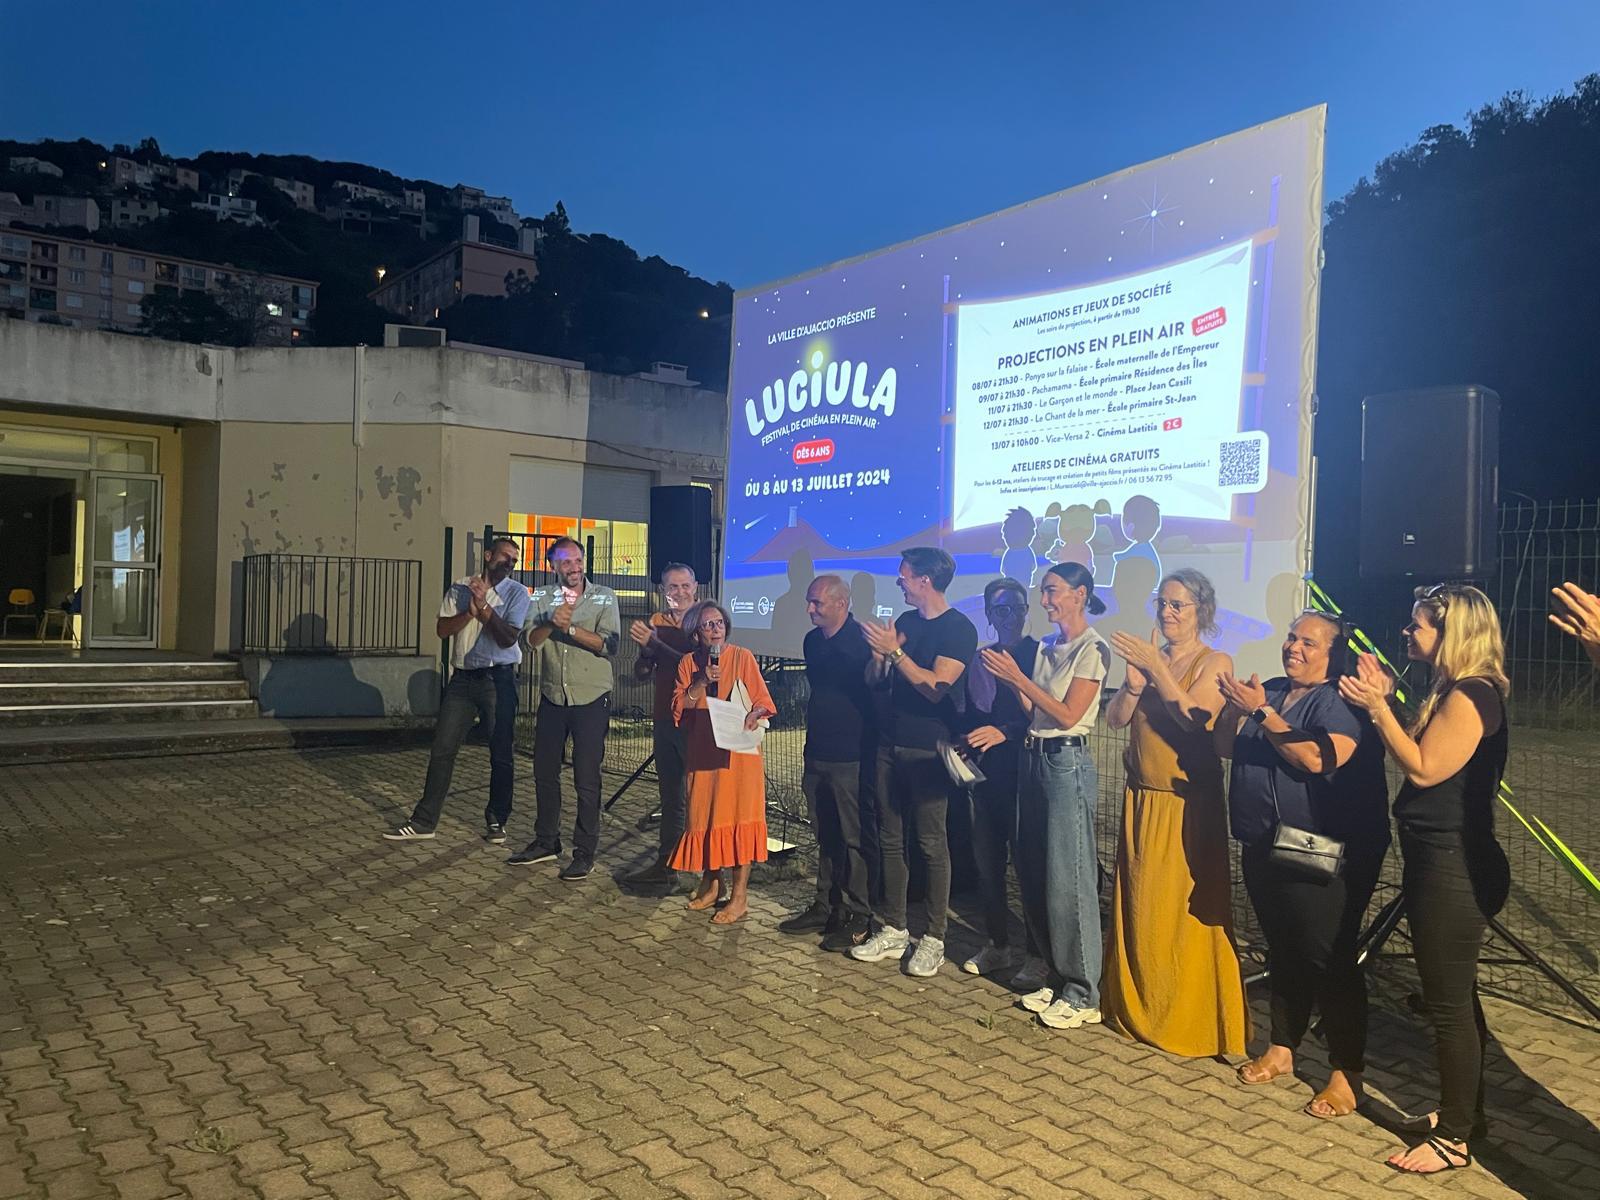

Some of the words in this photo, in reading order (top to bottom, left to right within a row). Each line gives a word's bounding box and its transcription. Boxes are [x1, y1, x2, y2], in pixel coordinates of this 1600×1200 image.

[1012, 308, 1070, 328] ANIMATIONS
[1072, 304, 1084, 316] ET
[1084, 297, 1110, 312] JEUX
[1112, 294, 1126, 306] DE
[1128, 280, 1172, 303] SOCIÉTÉ
[1098, 313, 1113, 324] partir
[1122, 306, 1140, 316] 19h30
[768, 334, 776, 344] LA
[778, 328, 796, 342] VILLE
[797, 318, 836, 338] D'AJACCIO
[836, 308, 876, 327] PRÉSENTE
[1196, 317, 1224, 334] GRATUITE
[998, 341, 1085, 370] PROJECTIONS
[1089, 336, 1108, 352] EN
[1112, 327, 1154, 348] PLEIN
[1157, 322, 1184, 340] AIR
[972, 380, 992, 390] 08/07
[998, 376, 1018, 386] 21h30
[1025, 372, 1046, 382] Ponyo
[1058, 368, 1064, 376] la
[1066, 365, 1088, 374] falaise
[1096, 358, 1115, 370] École
[1116, 350, 1158, 364] maternelle
[1160, 348, 1170, 358] de
[1172, 342, 1220, 356] l'Empereur
[978, 392, 998, 404] 09/07
[1004, 388, 1026, 400] 21h30
[1032, 384, 1072, 395] Pachamama
[1079, 376, 1098, 388] École
[1100, 372, 1132, 387] primaire
[1134, 364, 1174, 378] Résidence
[1176, 362, 1190, 372] des
[988, 404, 1006, 416] 11/07
[1012, 401, 1032, 412] 21h30
[1039, 399, 1048, 408] Le
[1048, 396, 1074, 406] Garçon
[1076, 394, 1083, 402] et
[1084, 392, 1091, 400] le
[1092, 388, 1118, 399] monde
[1126, 385, 1146, 394] Place
[1148, 382, 1166, 392] Jean
[984, 420, 1002, 430] 12/07
[1008, 416, 1028, 426] 21h30
[1035, 414, 1044, 423] Le
[1045, 412, 1066, 421] Chant
[1068, 410, 1076, 418] de
[1078, 408, 1084, 416] la
[1108, 401, 1128, 412] École
[1130, 398, 1162, 413] primaire
[1165, 394, 1196, 404] St-Jean
[762, 425, 790, 446] FESTIVAL
[791, 420, 800, 432] DE
[800, 414, 828, 428] CINÉMA
[830, 414, 840, 424] EN
[841, 414, 862, 426] PLEIN
[862, 417, 876, 429] AIR
[992, 440, 1010, 450] 13/07
[1016, 437, 1039, 447] 10h00
[1046, 432, 1083, 443] Vice-Versa
[1085, 430, 1090, 440] 2
[1097, 428, 1126, 437] Cinéma
[1128, 422, 1158, 434] Laetitia
[810, 448, 814, 458] 6
[815, 446, 830, 456] ANS
[1012, 460, 1052, 472] ATELIERS
[1054, 458, 1066, 468] DE
[1068, 453, 1108, 467] CINÉMA
[1110, 448, 1160, 463] GRATUITS
[746, 482, 760, 496] DU
[763, 482, 770, 495] 8
[773, 480, 788, 494] AU
[792, 478, 803, 492] 13
[806, 472, 853, 491] JUILLET
[856, 468, 890, 486] 2024
